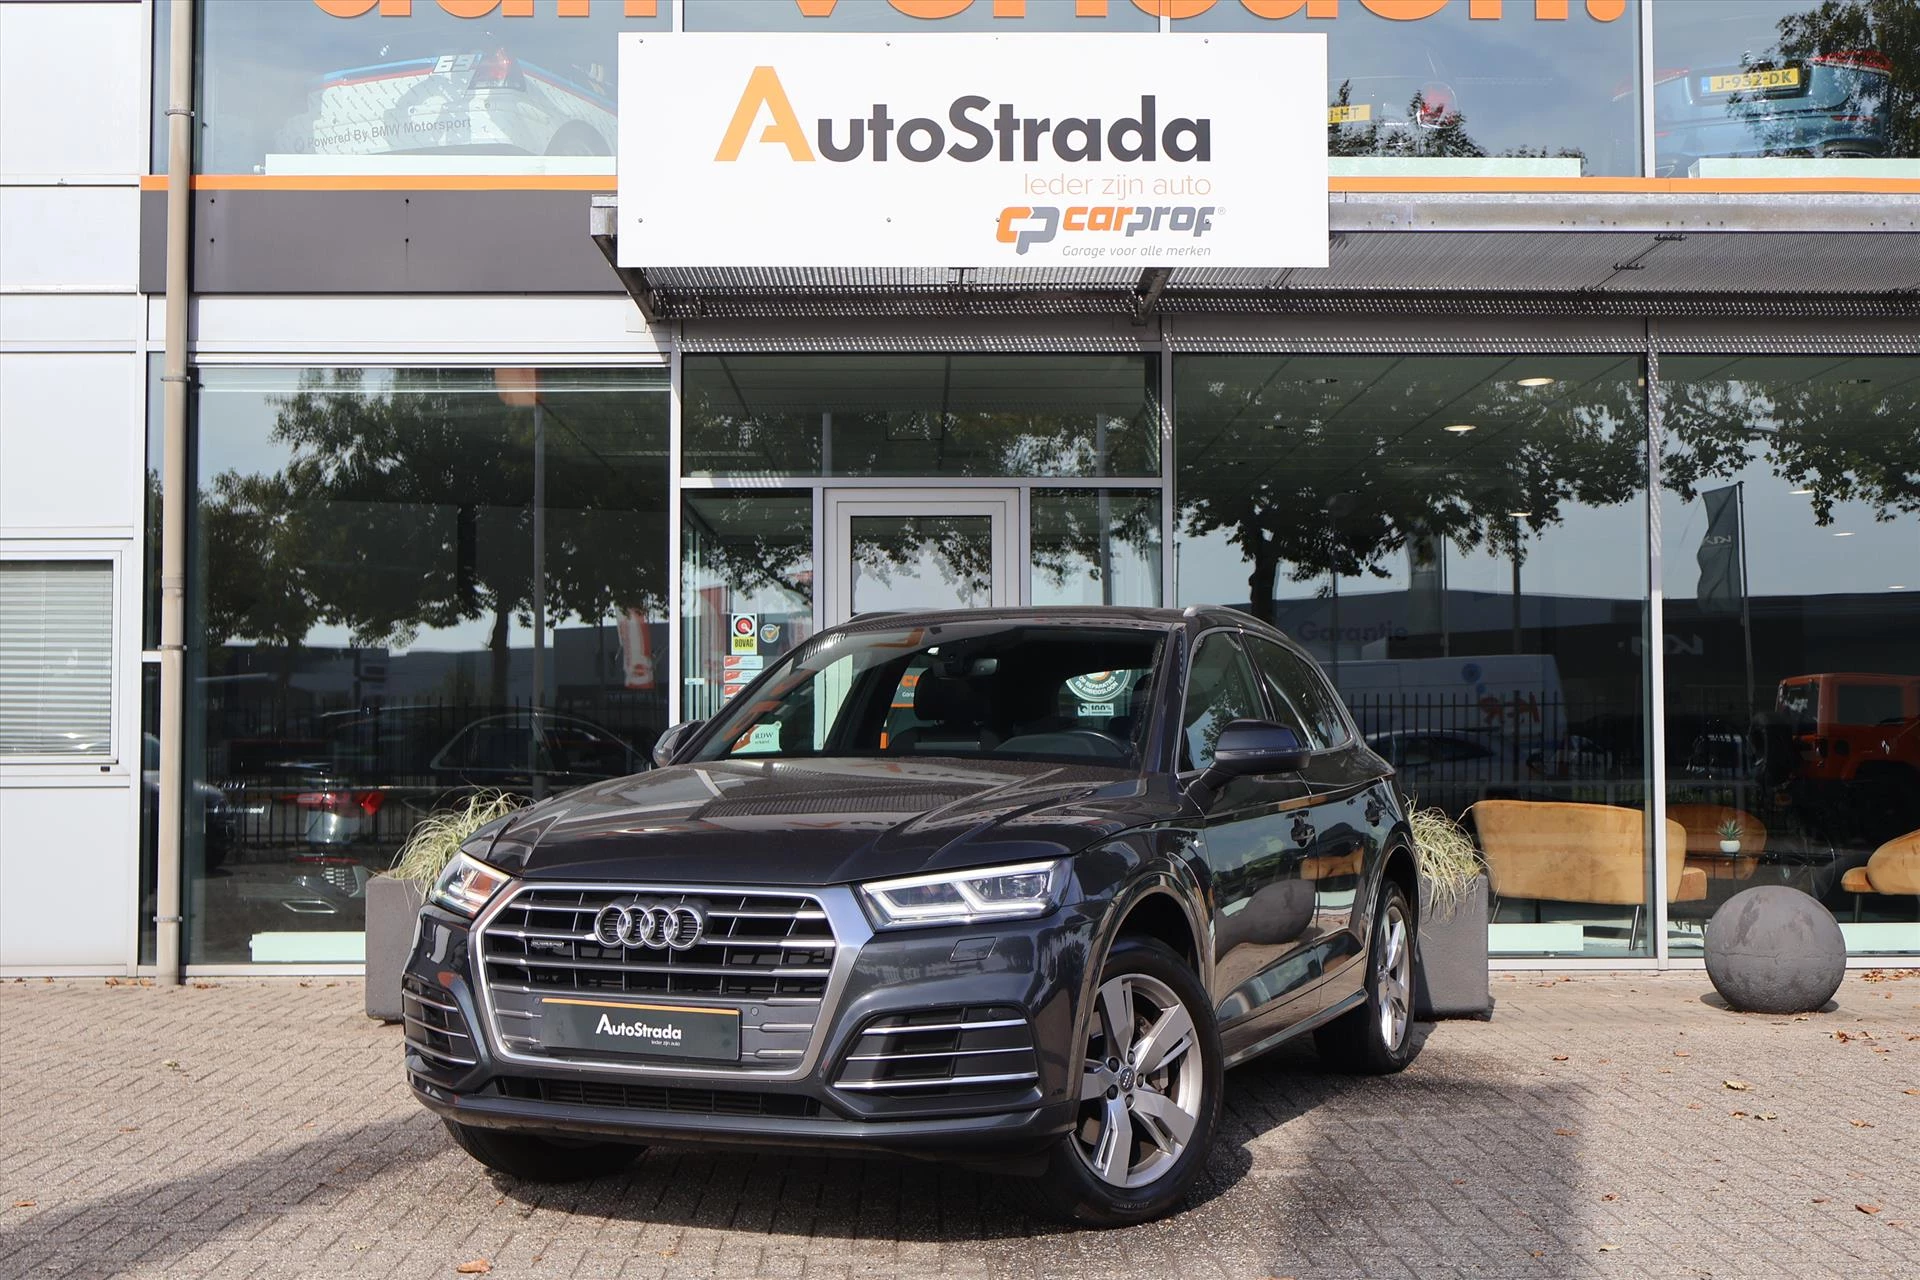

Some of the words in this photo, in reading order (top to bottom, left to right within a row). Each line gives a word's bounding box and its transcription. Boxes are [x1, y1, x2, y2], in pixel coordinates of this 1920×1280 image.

[434, 55, 475, 73] 69
[715, 66, 1211, 162] AutoStrada
[308, 129, 351, 149] Powered
[354, 128, 369, 143] By
[372, 124, 400, 138] BMW
[403, 118, 472, 134] Motorsport
[1025, 173, 1092, 195] Ieder
[1102, 174, 1143, 200] zijn
[1154, 176, 1211, 195] auto
[1063, 207, 1215, 237] carprof
[1063, 245, 1105, 258] Garage
[1111, 247, 1136, 256] voor
[1141, 245, 1162, 256] alle
[1167, 245, 1211, 256] merken
[734, 638, 754, 648] BOVAG
[1297, 620, 1408, 642] Garantie
[595, 1013, 682, 1040] AutoStrada
